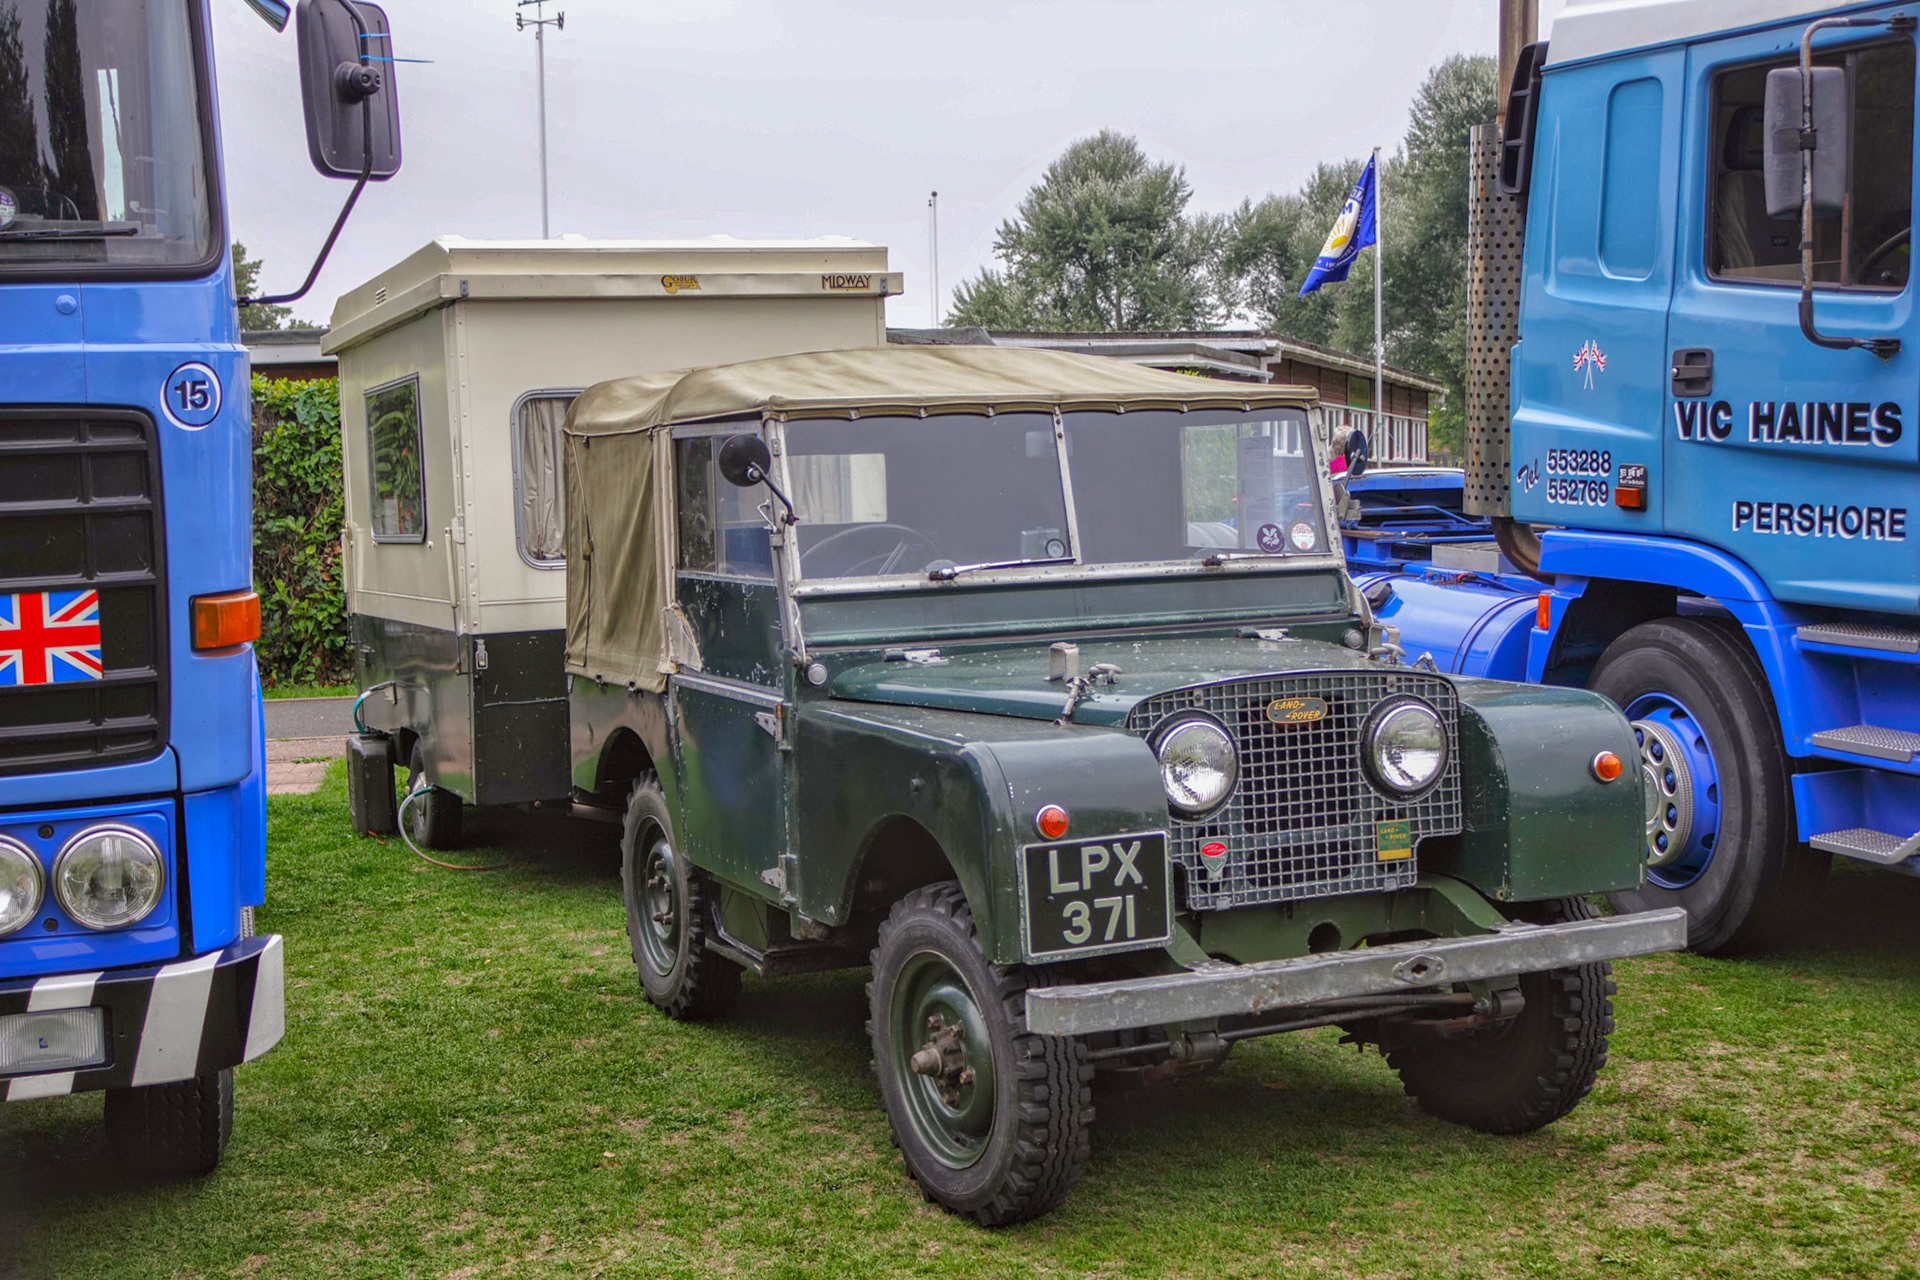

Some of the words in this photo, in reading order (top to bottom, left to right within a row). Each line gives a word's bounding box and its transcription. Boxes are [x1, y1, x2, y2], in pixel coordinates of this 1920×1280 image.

[822, 275, 871, 290] MIDWAY
[174, 380, 211, 411] 15
[1674, 401, 1732, 442] VIC
[1748, 402, 1902, 447] HAINES
[1517, 457, 1540, 493] Tel
[1546, 449, 1611, 477] 553288
[1619, 468, 1643, 477] ERF
[1546, 478, 1609, 507] 552769
[1732, 501, 1906, 541] PERSHORE
[1274, 700, 1300, 711] LAND
[1290, 710, 1320, 721] ROVER
[1049, 841, 1143, 894] LPX
[1062, 895, 1136, 944] 371
